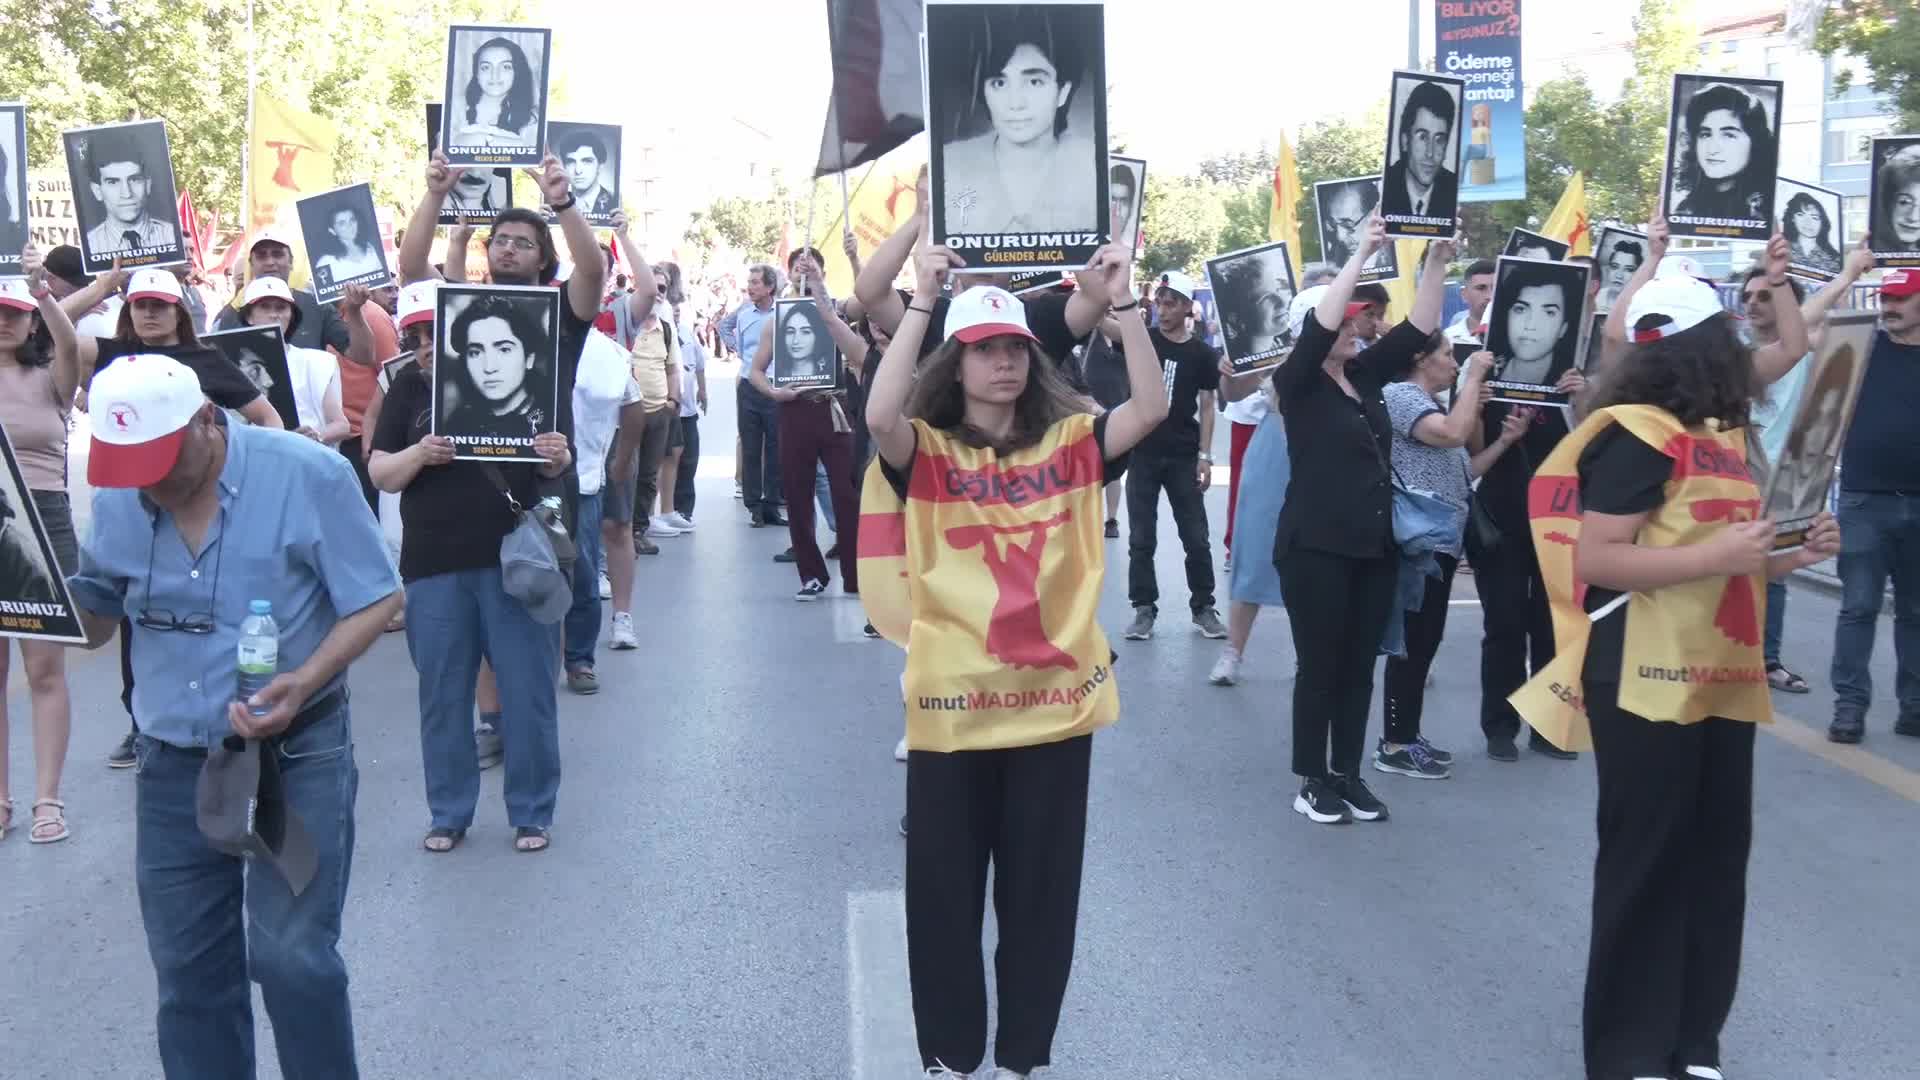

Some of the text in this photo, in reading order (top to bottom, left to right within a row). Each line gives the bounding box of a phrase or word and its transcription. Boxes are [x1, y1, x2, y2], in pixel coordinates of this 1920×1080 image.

[1445, 51, 1513, 70] Ödeme
[448, 147, 537, 155] ONURUMUZ
[439, 208, 500, 217] ONURUMU
[1385, 214, 1452, 226] ONURUMUZ
[1669, 216, 1767, 229] ONURUMUZ
[945, 233, 1099, 249] ONURUMUZ
[984, 250, 1064, 263] GÜLENDER AKÇA
[778, 374, 831, 382] ONURUMUZ
[1486, 380, 1558, 393] ONURUMU
[444, 435, 534, 446] ONURUMU
[0, 600, 68, 617] RUMUZ
